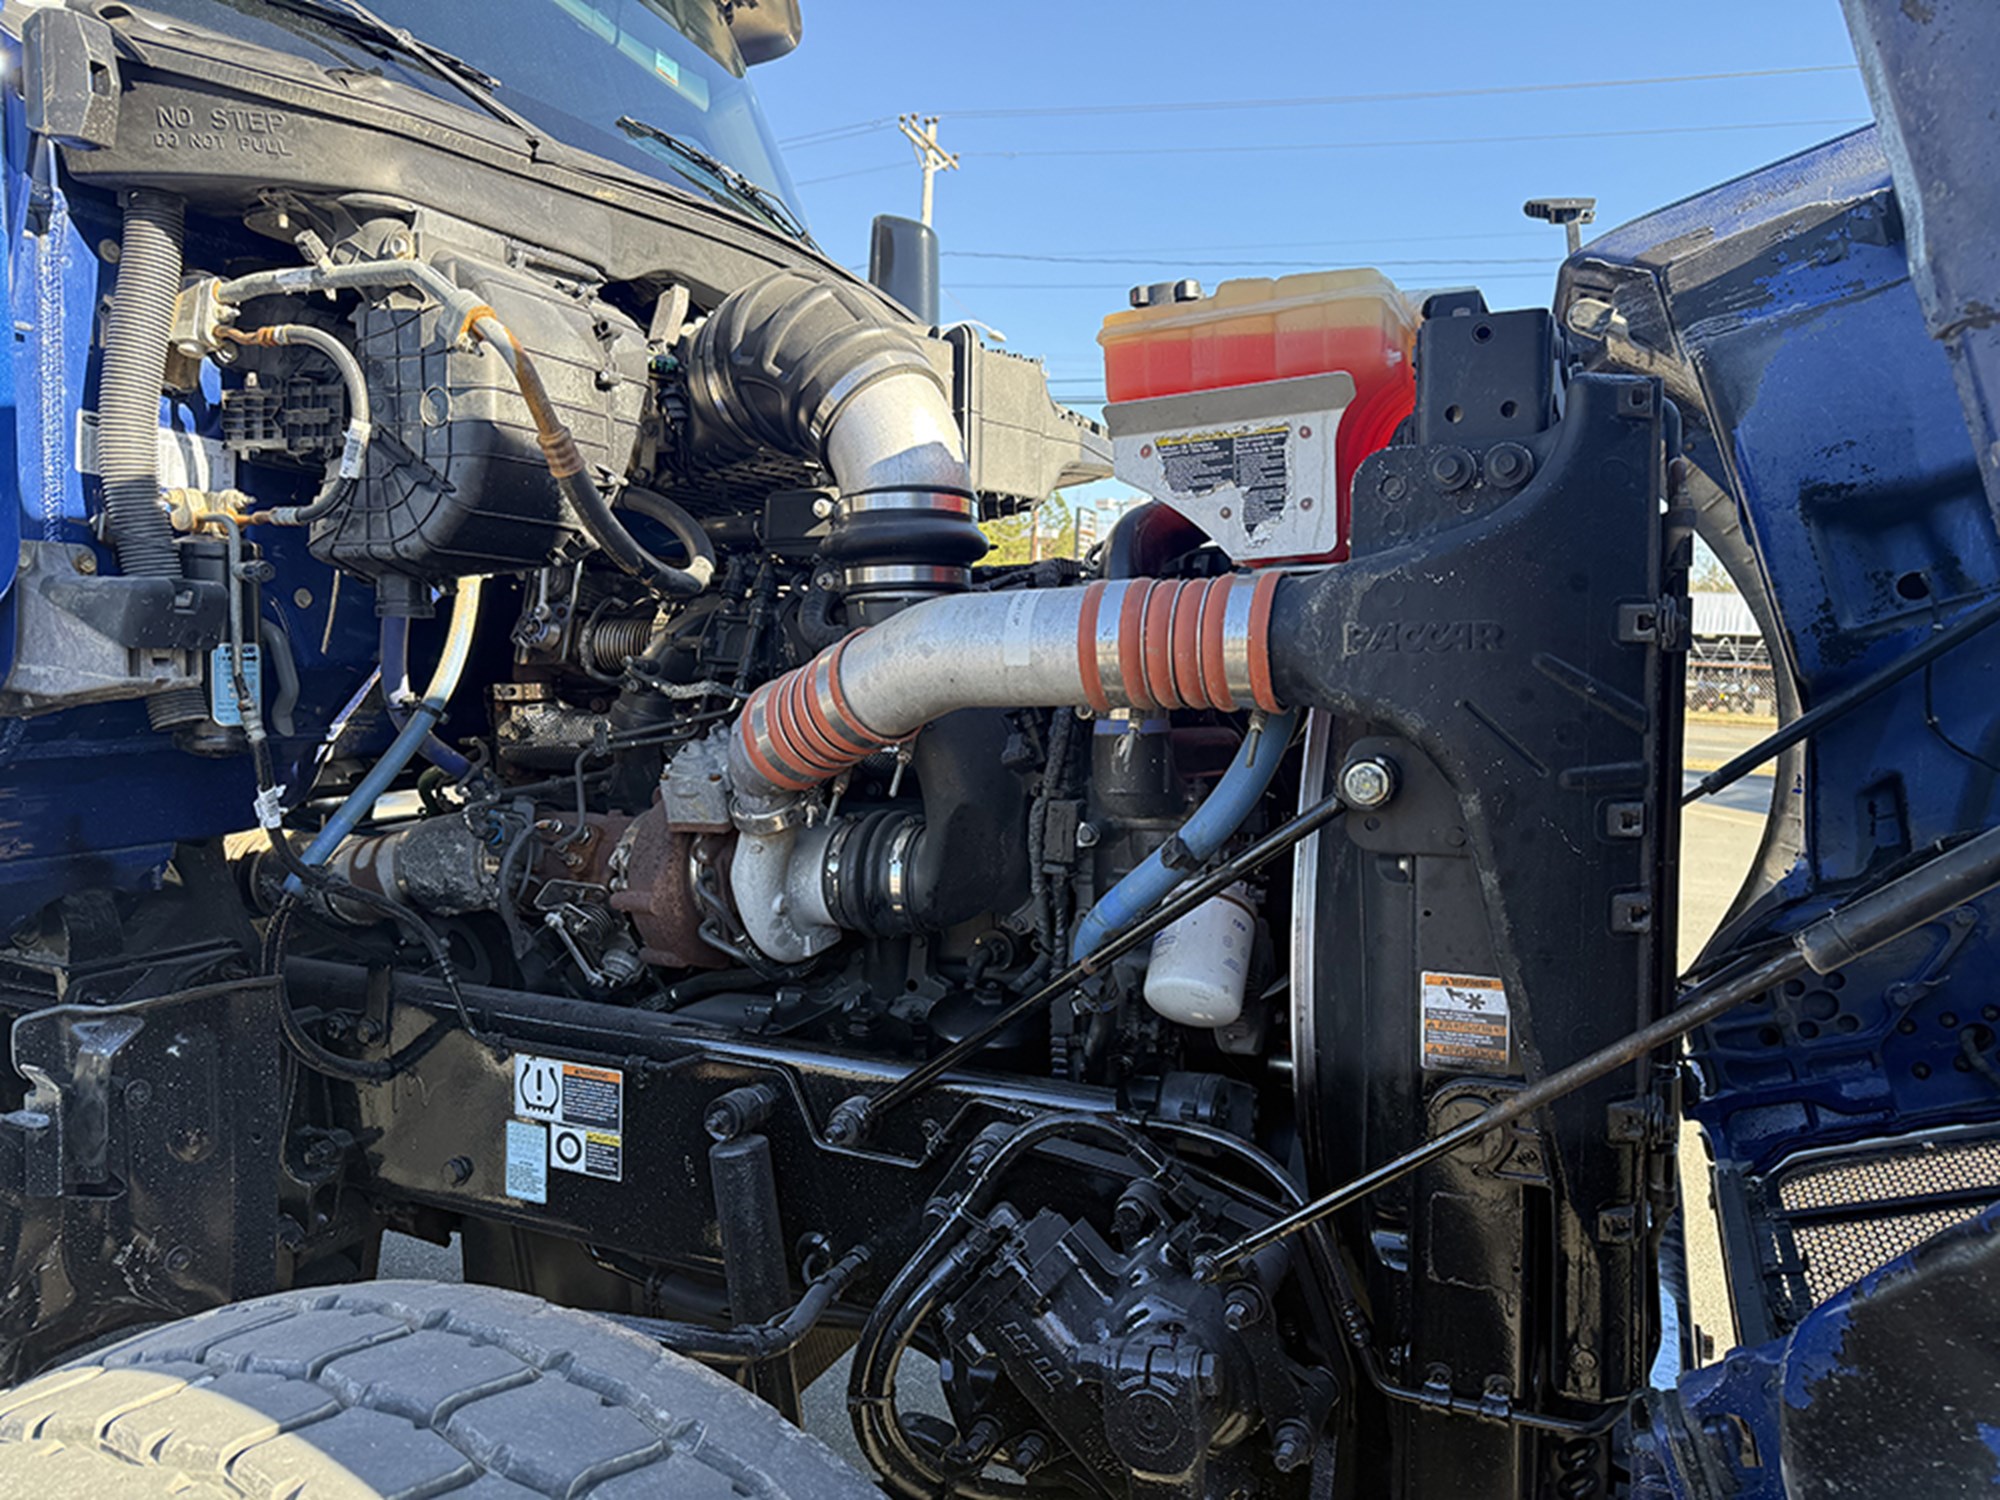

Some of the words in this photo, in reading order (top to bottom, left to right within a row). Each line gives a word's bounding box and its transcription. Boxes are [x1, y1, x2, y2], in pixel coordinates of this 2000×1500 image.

[156, 105, 194, 129] NO
[210, 107, 286, 134] STEP
[153, 132, 180, 149] DO
[189, 133, 225, 150] NOT
[238, 136, 293, 157] PULL
[1343, 620, 1504, 656] PACCAR
